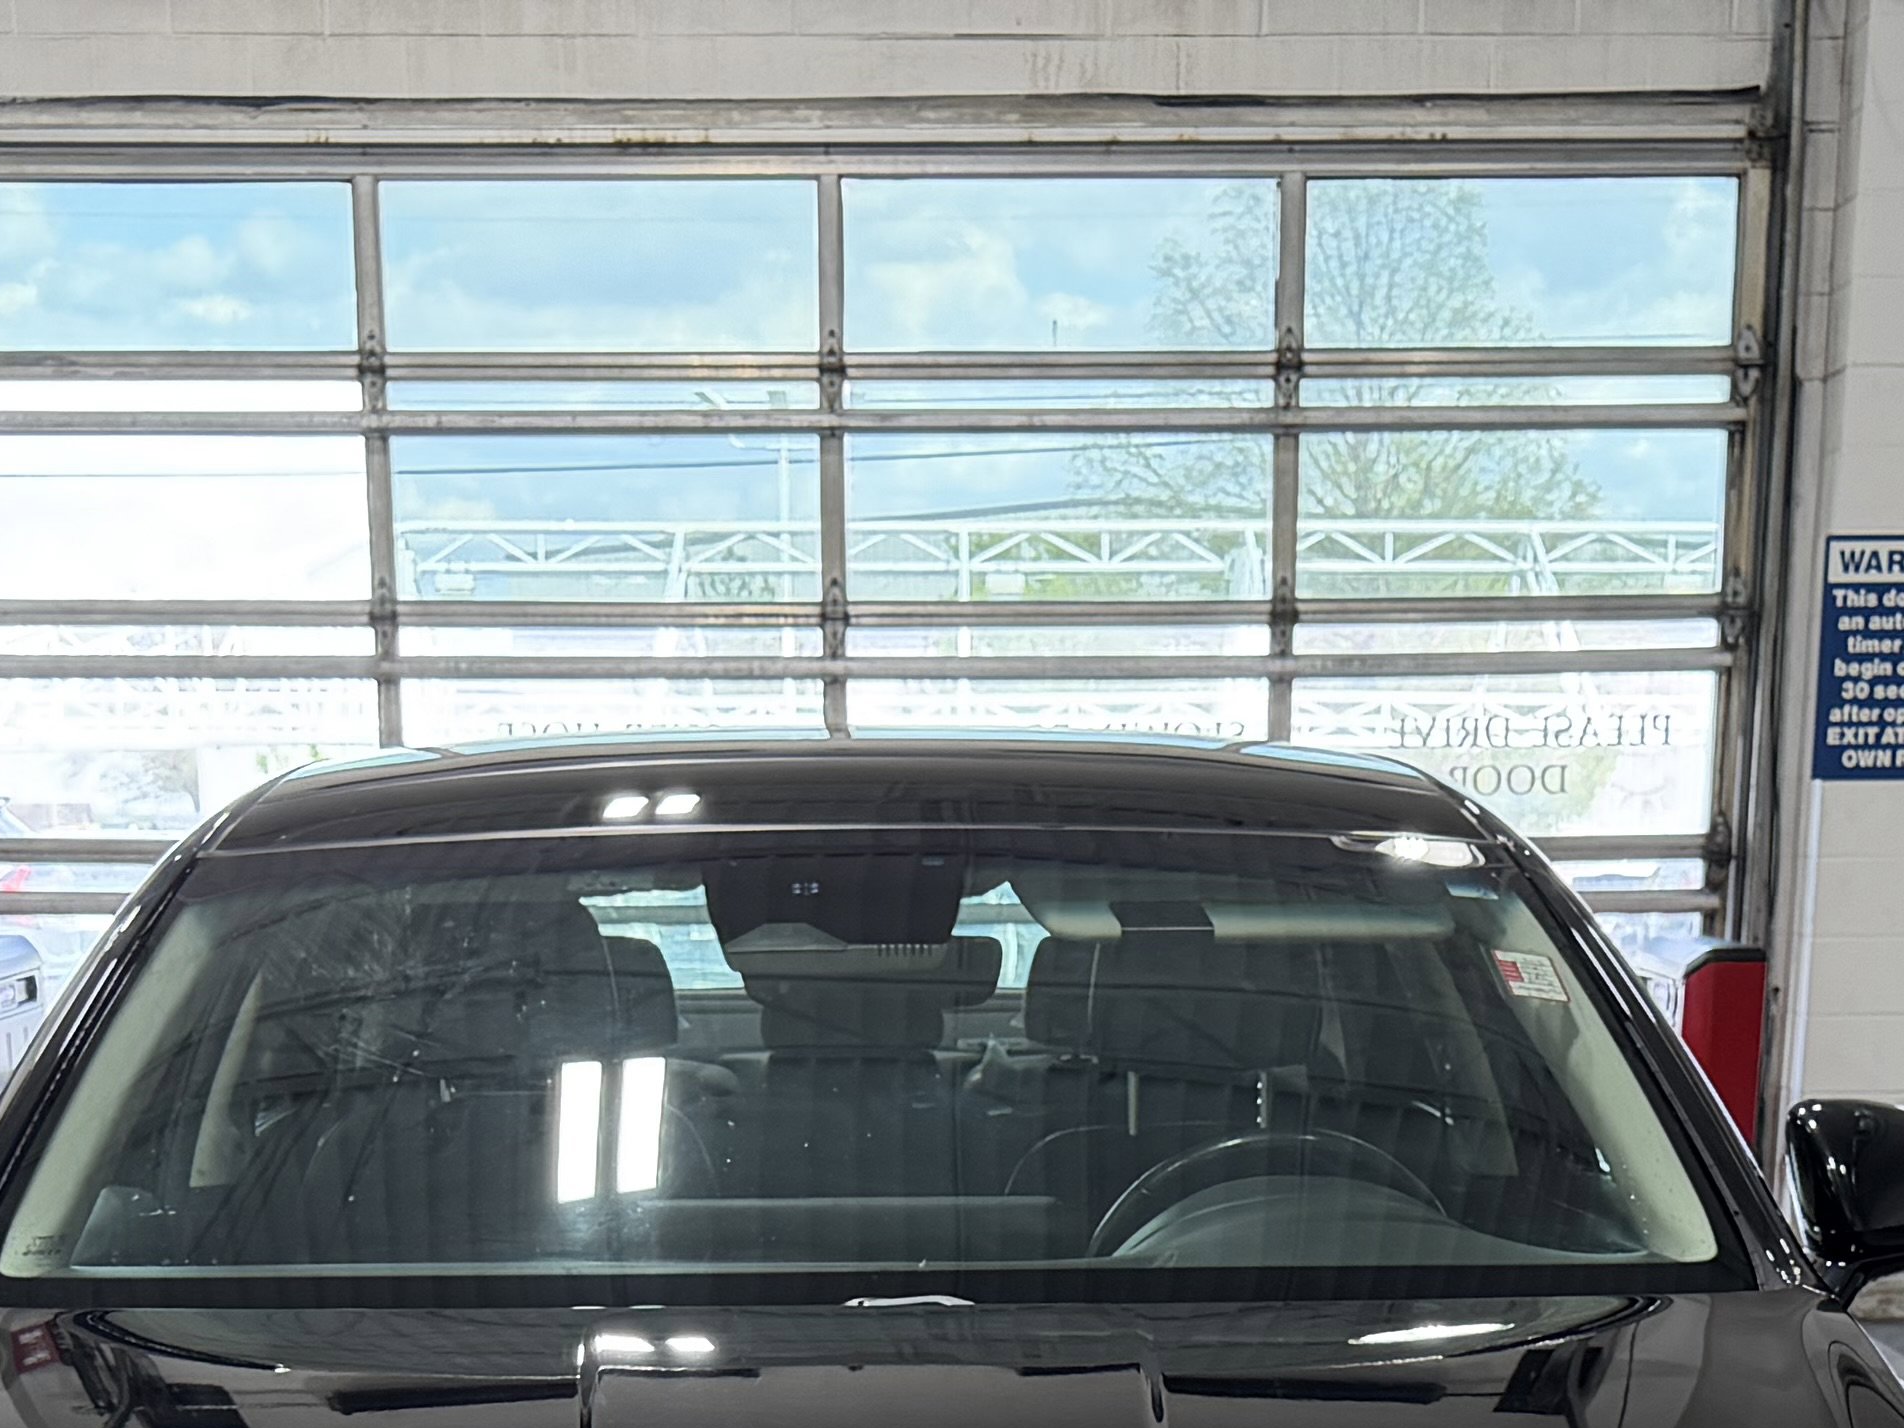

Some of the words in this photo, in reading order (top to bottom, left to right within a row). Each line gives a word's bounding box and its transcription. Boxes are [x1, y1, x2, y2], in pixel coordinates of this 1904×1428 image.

[1832, 587, 1878, 607] This
[1838, 614, 1865, 631] an
[1847, 634, 1903, 654] timer
[1833, 657, 1893, 680] begin
[1841, 681, 1870, 700] 30
[1828, 703, 1881, 723] after
[1826, 726, 1880, 745] EXIT
[1841, 749, 1892, 768] OWN
